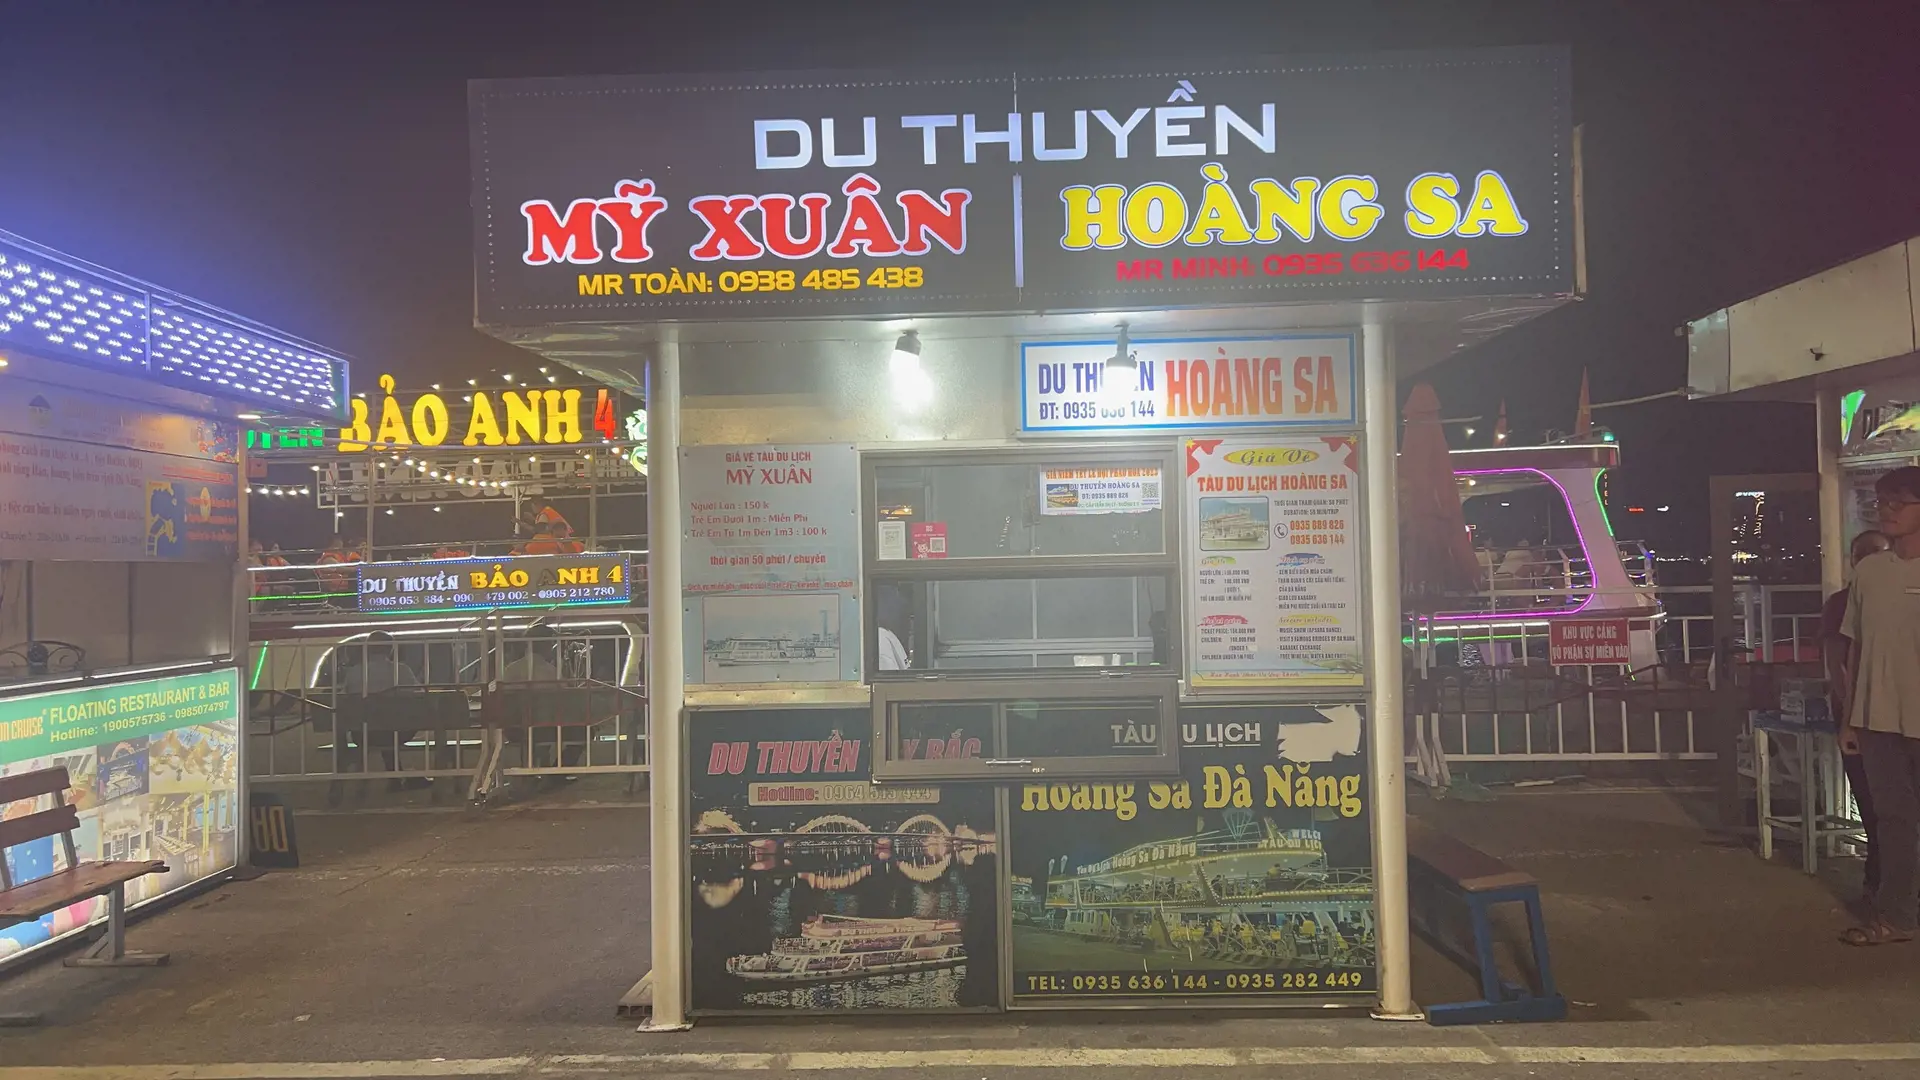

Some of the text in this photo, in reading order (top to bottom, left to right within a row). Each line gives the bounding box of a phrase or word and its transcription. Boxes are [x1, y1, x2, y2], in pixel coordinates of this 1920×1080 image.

[754, 80, 1276, 169] DU THUYỀN
[1060, 162, 1529, 251] HOÀNG SA
[521, 172, 973, 266] MỸ XUÂN
[1116, 248, 1470, 282] MR MINH: 0935 636 144
[578, 266, 925, 296] MR TOÀN: 0938 485 438
[1038, 363, 1066, 394] DU
[1166, 347, 1283, 416] HOÀNG
[1293, 356, 1338, 414] SA
[338, 374, 617, 452] BẢO ANH 4
[1039, 401, 1059, 420] ĐT:
[1063, 400, 1096, 419] 0935
[1130, 400, 1155, 417] 144
[776, 451, 789, 461] DU
[791, 451, 811, 464] LỊCH
[1240, 449, 1312, 466] Giá Vé
[726, 463, 812, 486] MỸ XUÂN
[1197, 472, 1347, 494] TÀU DU LỊCH HOÀNG SA
[707, 515, 721, 524] Em
[747, 515, 761, 523] 1m
[1290, 520, 1310, 530] 0935
[707, 529, 721, 538] Em
[738, 529, 750, 537] 1m
[774, 527, 794, 536] 1m3
[801, 527, 819, 536] 100
[1290, 534, 1310, 545] 0935
[1330, 534, 1345, 544] 144
[730, 555, 750, 567] gian
[752, 554, 763, 565] 50
[362, 564, 623, 594] DU THUYỀN BẢO ANH 4
[569, 588, 591, 597] 212
[593, 586, 615, 596] 780
[1562, 623, 1617, 642] KHU VỰC CẢNG
[1552, 645, 1561, 660] VÔ
[1585, 645, 1594, 661] SỰ
[1615, 644, 1628, 659] VÀO
[50, 699, 117, 725] FLOATING
[119, 685, 197, 713] RESTAURANT
[198, 684, 207, 698] &
[208, 680, 230, 697] BAR
[50, 725, 98, 743] Hotline:
[102, 712, 167, 734] 1900575736
[175, 700, 230, 719] 0985074797
[1111, 718, 1157, 743] TÀU
[1206, 722, 1262, 748] LỊCH
[707, 742, 749, 775] DU
[756, 729, 861, 774] THUYỀN
[925, 728, 982, 761] BẮC
[757, 786, 819, 802] Hotline:
[823, 784, 868, 801] 0964
[1202, 763, 1254, 809] Đà
[1138, 851, 1149, 863] Sa
[1152, 847, 1165, 861] Đà
[1028, 975, 1066, 990] TEL:
[1072, 975, 1121, 990] 0935
[1128, 975, 1165, 990] 636
[1172, 975, 1208, 989] 144
[1226, 973, 1275, 988] 0935
[1282, 973, 1319, 988] 282
[1325, 972, 1362, 987] 449
